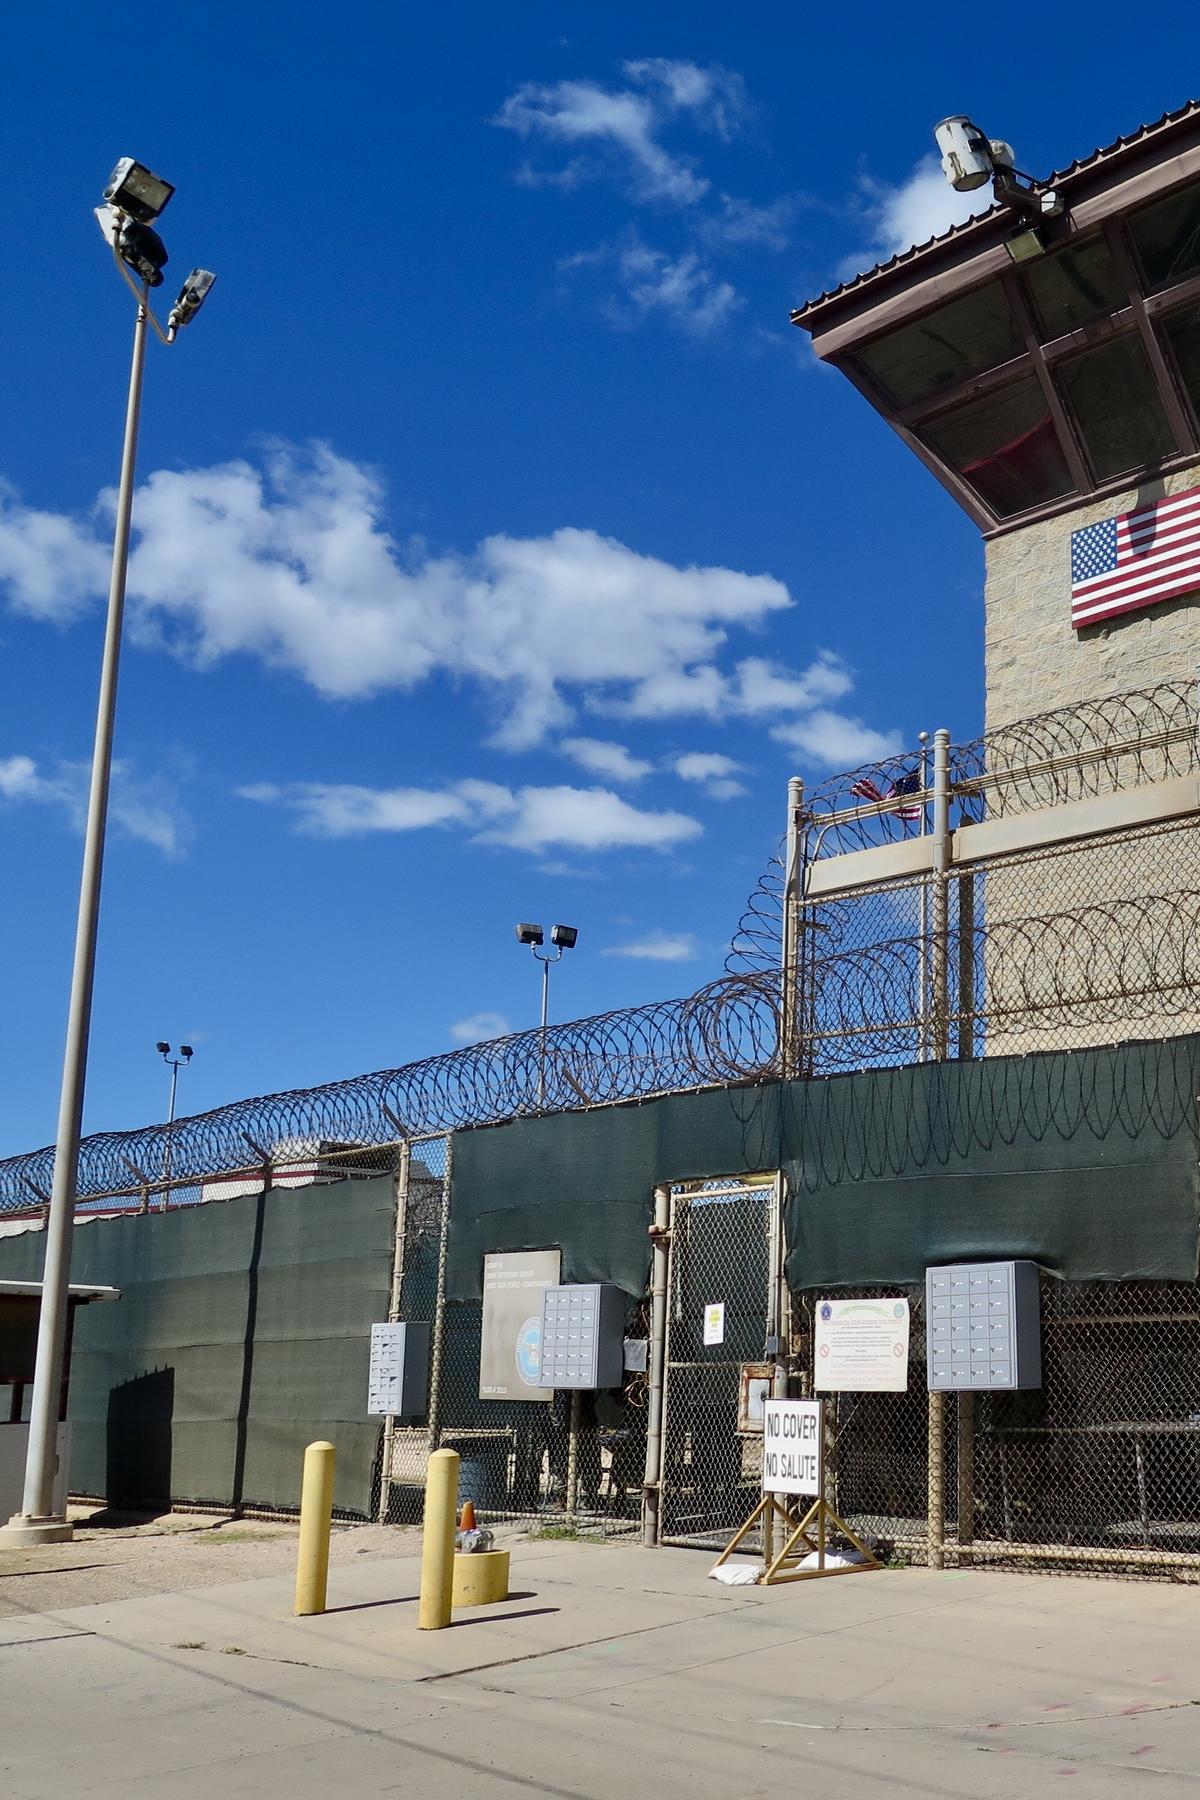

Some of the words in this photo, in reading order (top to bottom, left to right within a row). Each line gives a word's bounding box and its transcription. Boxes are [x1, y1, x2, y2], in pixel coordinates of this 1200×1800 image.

[768, 1412, 780, 1438] NO
[783, 1413, 816, 1440] COVER
[766, 1452, 778, 1477] NO
[781, 1454, 816, 1480] SALUTE
